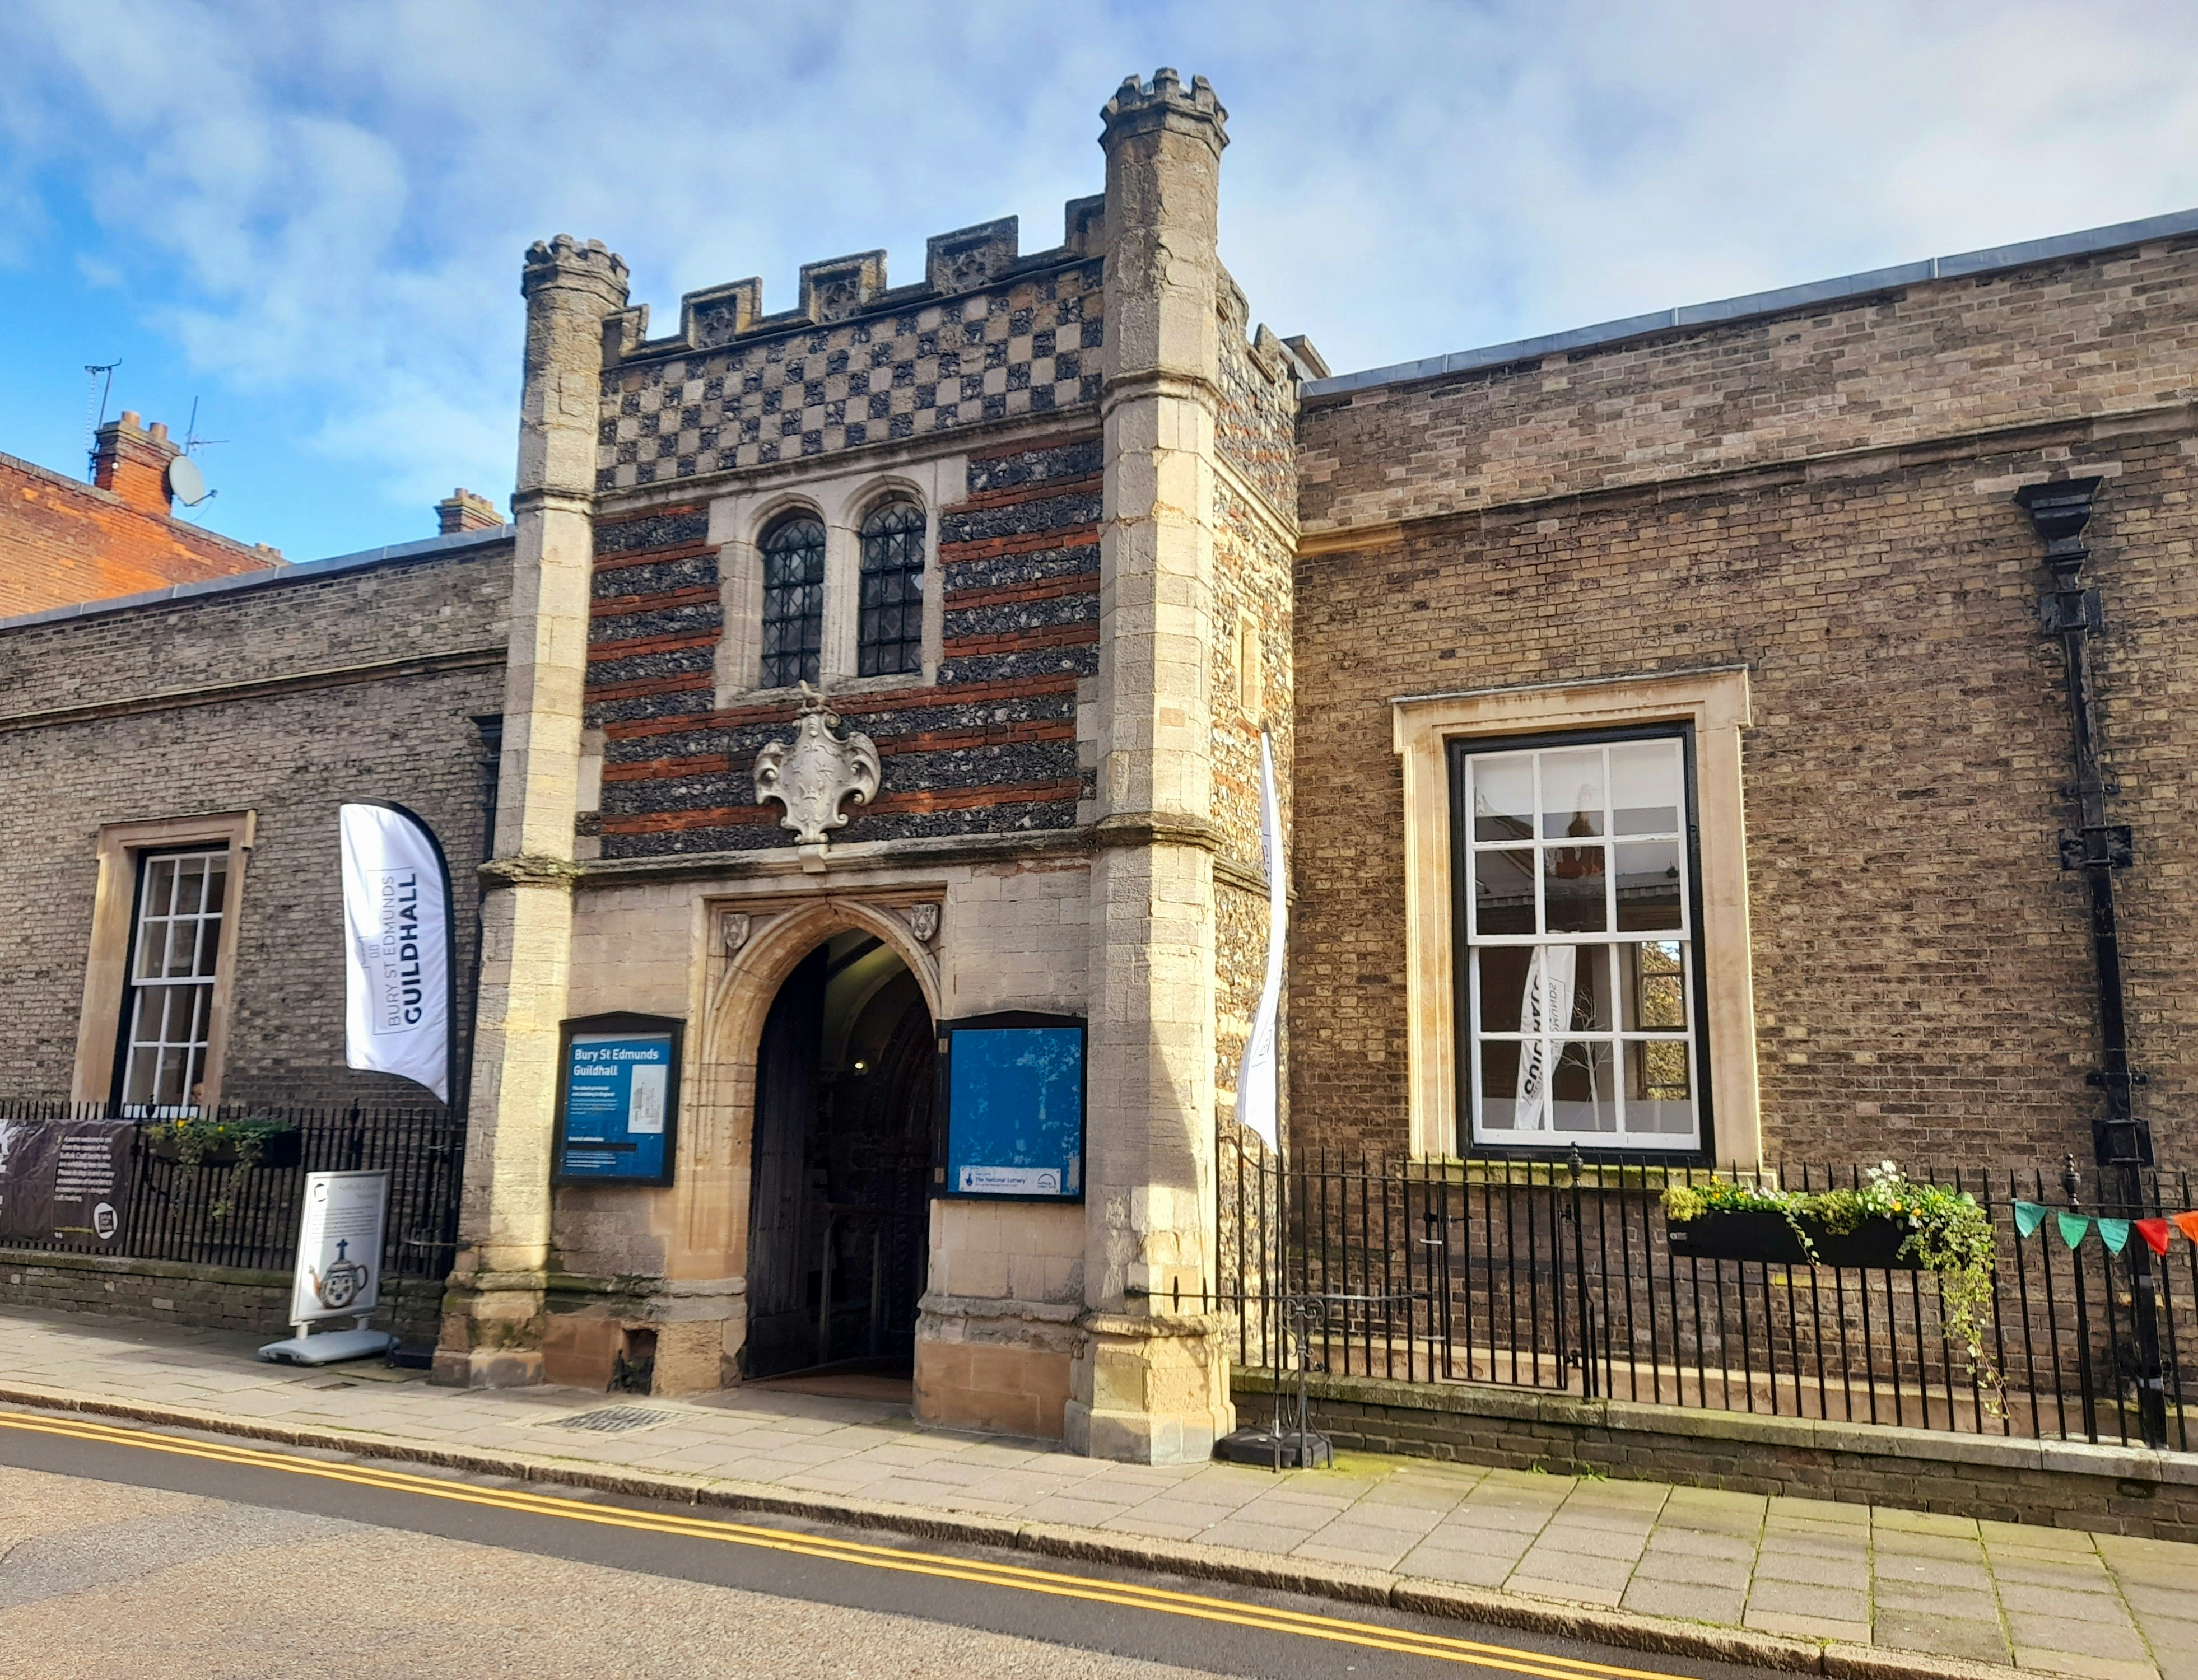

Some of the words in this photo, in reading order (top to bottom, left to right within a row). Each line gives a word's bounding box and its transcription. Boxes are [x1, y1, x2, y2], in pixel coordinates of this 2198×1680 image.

[381, 876, 395, 955] EDMUNDS
[398, 874, 421, 1024] GUILDHALL
[383, 962, 397, 978] ST
[385, 984, 400, 1026] BURY
[574, 1049, 598, 1062] Bury
[599, 1049, 611, 1060] St
[612, 1048, 659, 1060] Edmunds
[573, 1065, 618, 1076] Guildhall
